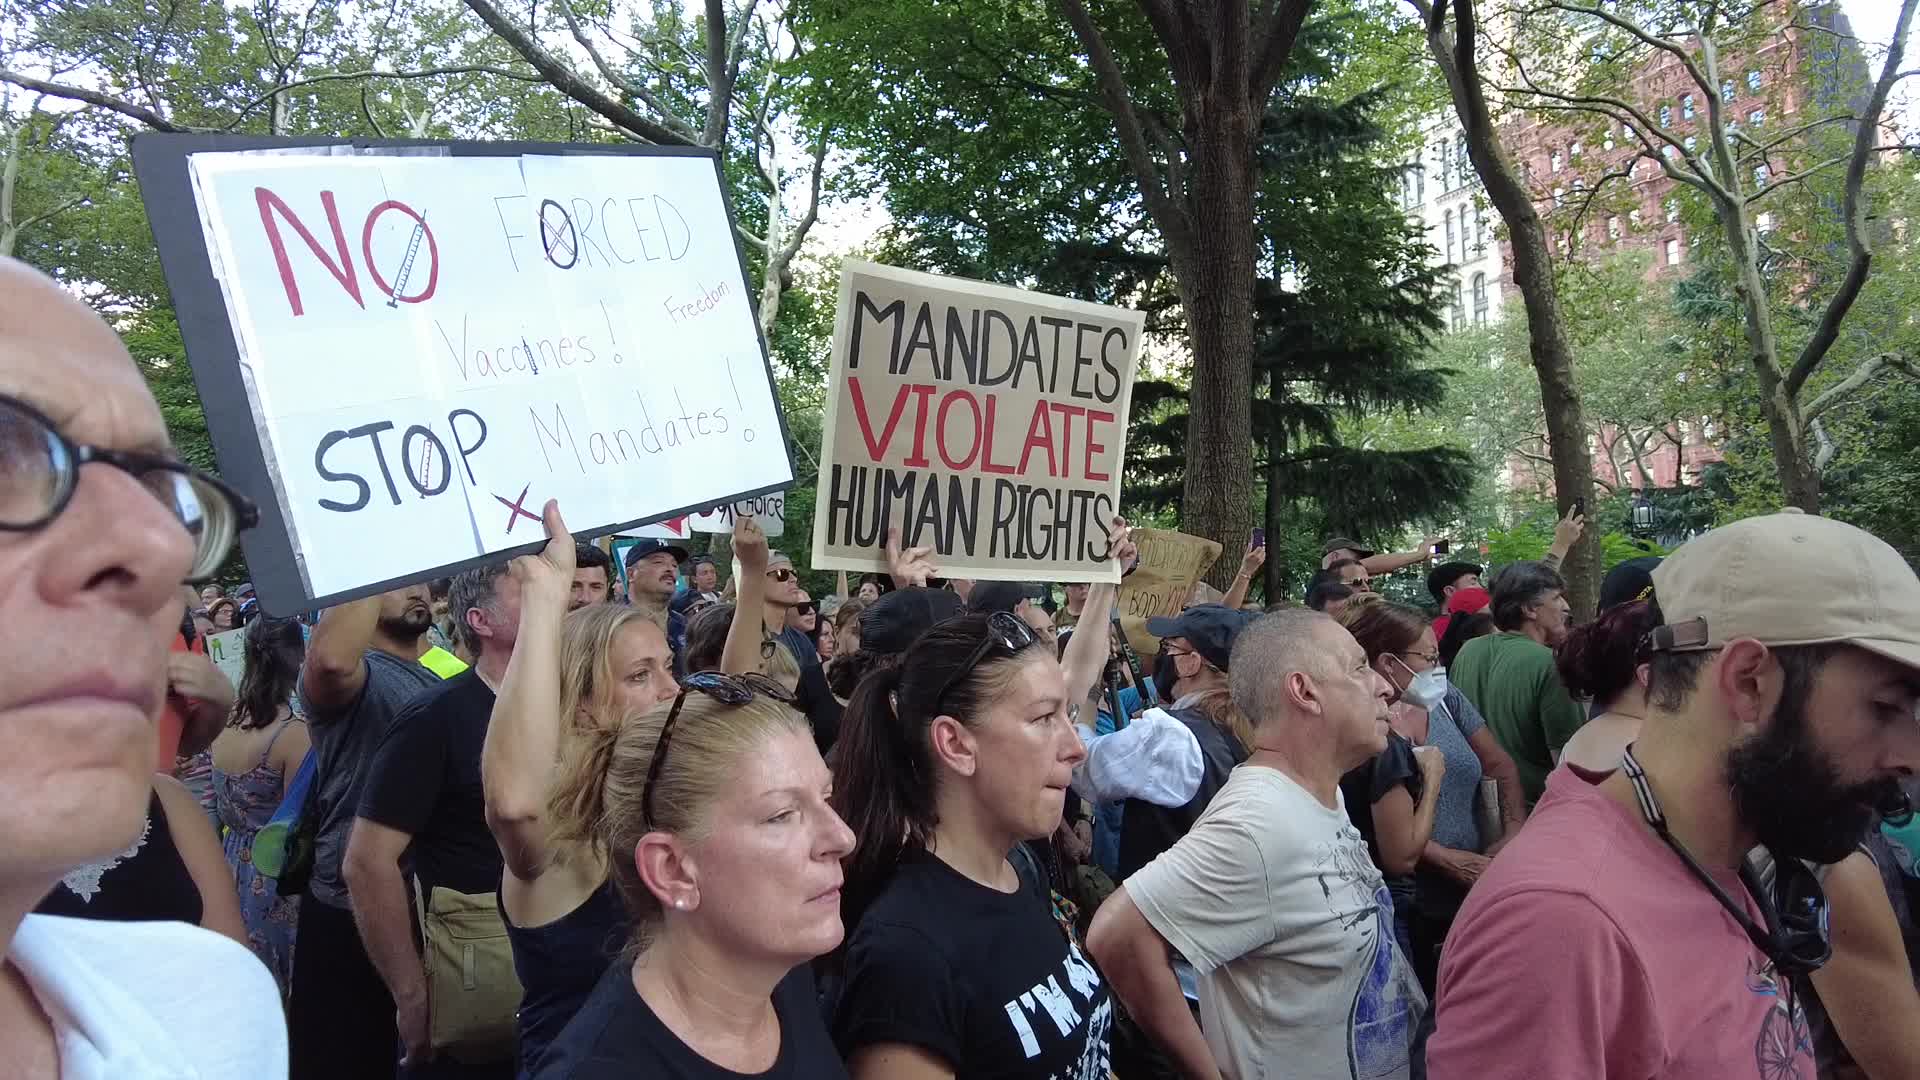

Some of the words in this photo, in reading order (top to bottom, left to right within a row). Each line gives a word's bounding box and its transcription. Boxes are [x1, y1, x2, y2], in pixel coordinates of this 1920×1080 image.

[255, 186, 438, 316] NO
[494, 194, 691, 272] FORCED
[664, 280, 731, 324] Freedom
[849, 291, 1127, 403] MANDATES
[314, 408, 487, 512] STOP
[847, 376, 1114, 481] VIOLATE
[827, 464, 980, 556] HUMAN
[989, 477, 1112, 563] RIGHTS
[1128, 588, 1160, 618] BODY
[1004, 973, 1083, 1058] I'M
